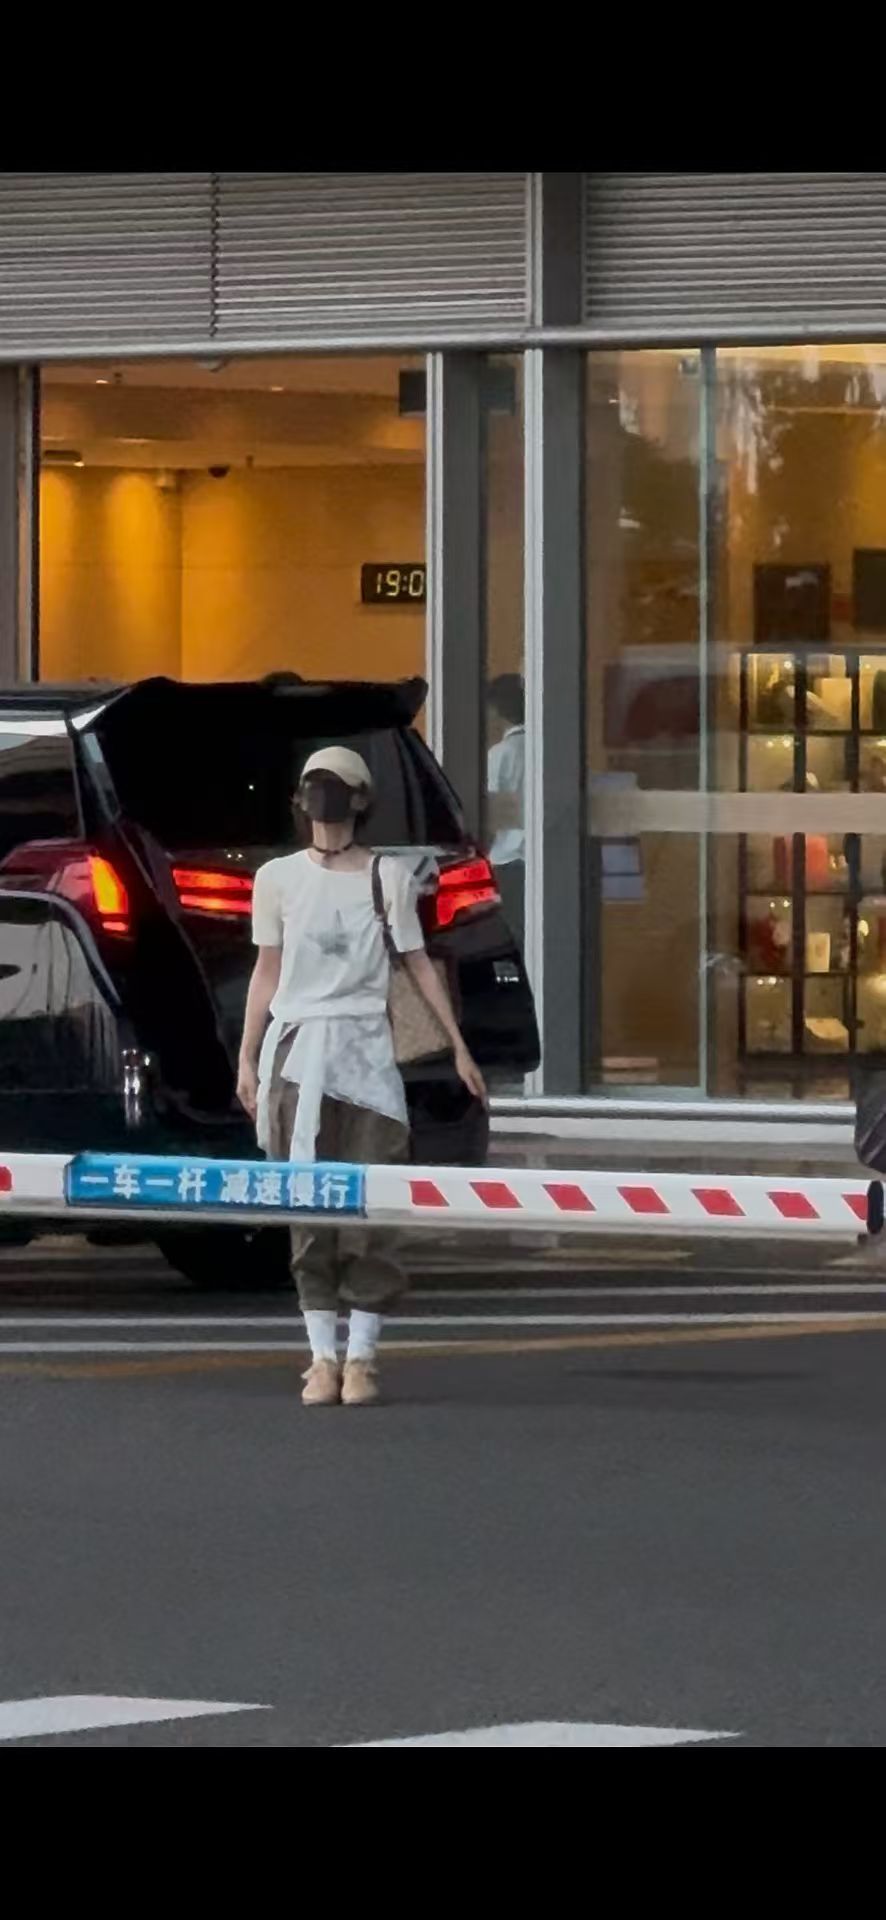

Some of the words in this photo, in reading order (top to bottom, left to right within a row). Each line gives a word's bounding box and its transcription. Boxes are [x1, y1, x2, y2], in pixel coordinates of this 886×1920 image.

[376, 570, 425, 597] 19:0
[80, 1164, 207, 1202] 一车一杆
[220, 1169, 350, 1208] 减速慢行
